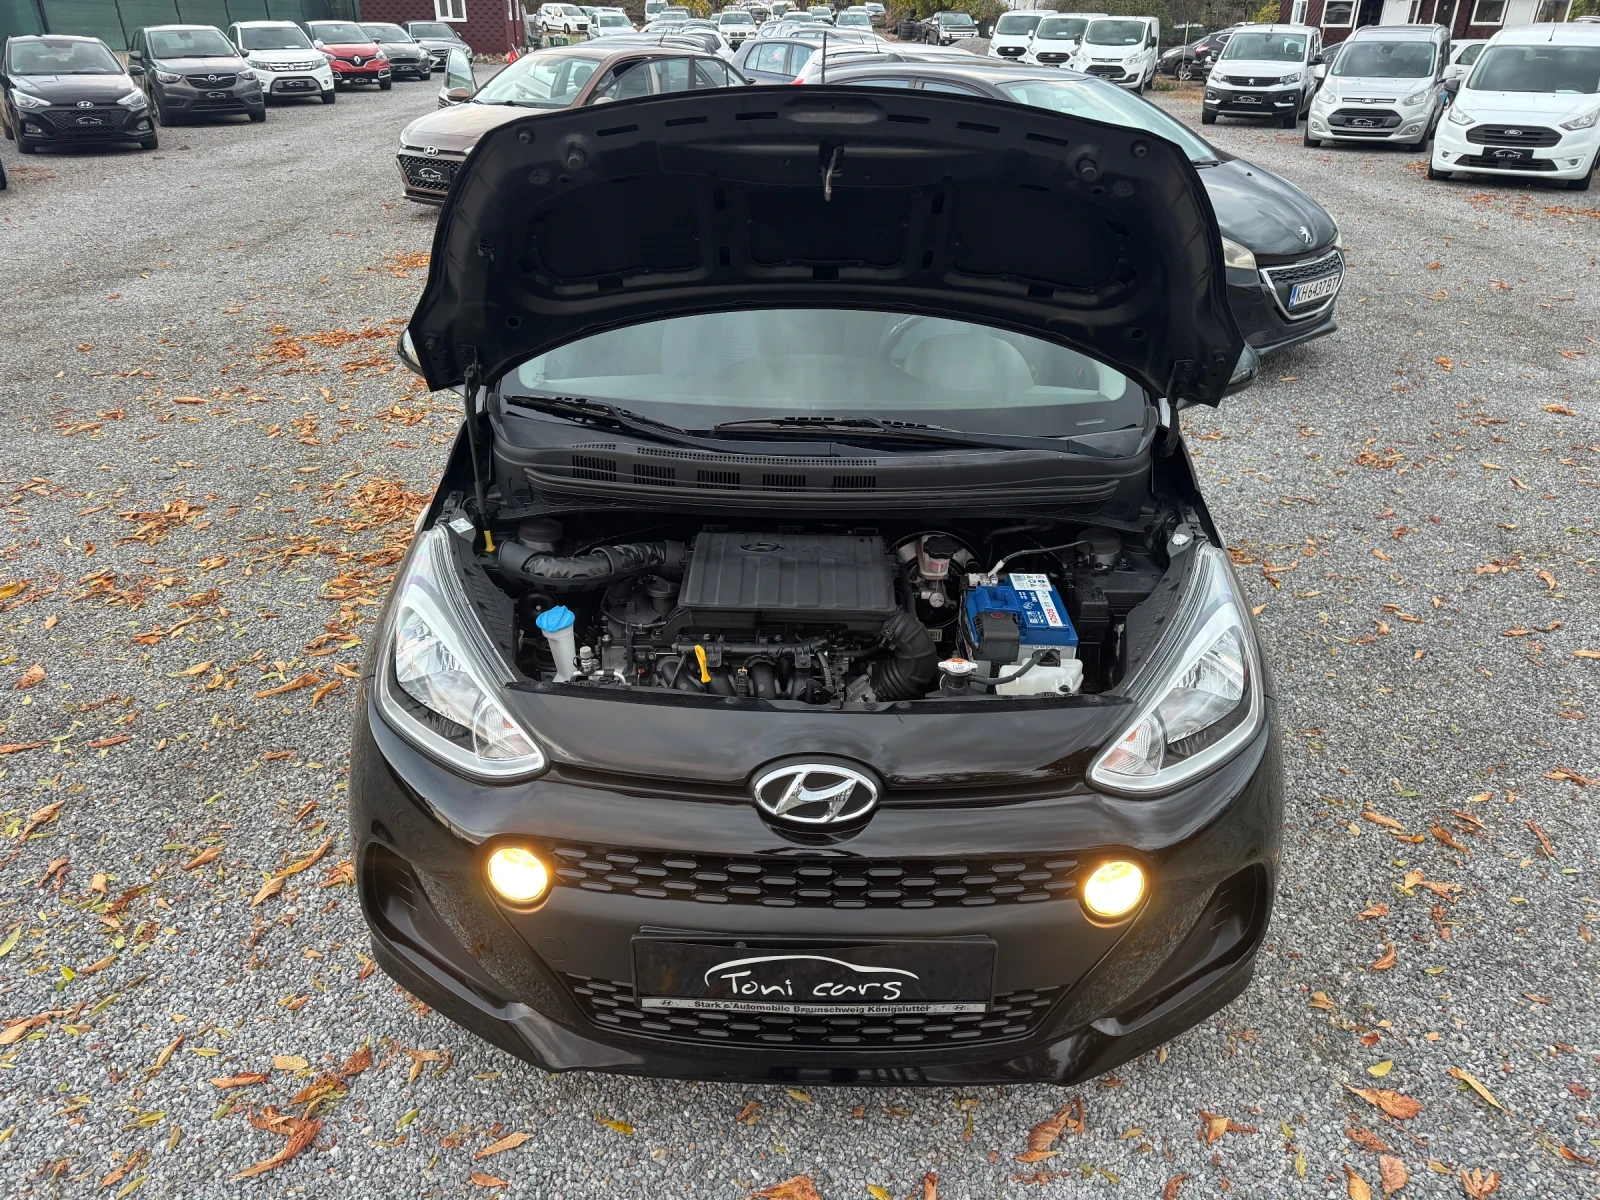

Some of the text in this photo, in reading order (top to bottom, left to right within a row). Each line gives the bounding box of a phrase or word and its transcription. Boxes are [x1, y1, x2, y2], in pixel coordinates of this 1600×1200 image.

[720, 970, 903, 1001] Toni cars
[732, 1003, 790, 1012] Automobile
[793, 1005, 864, 1014] Braunschweig
[867, 1005, 931, 1014] Königslutter
